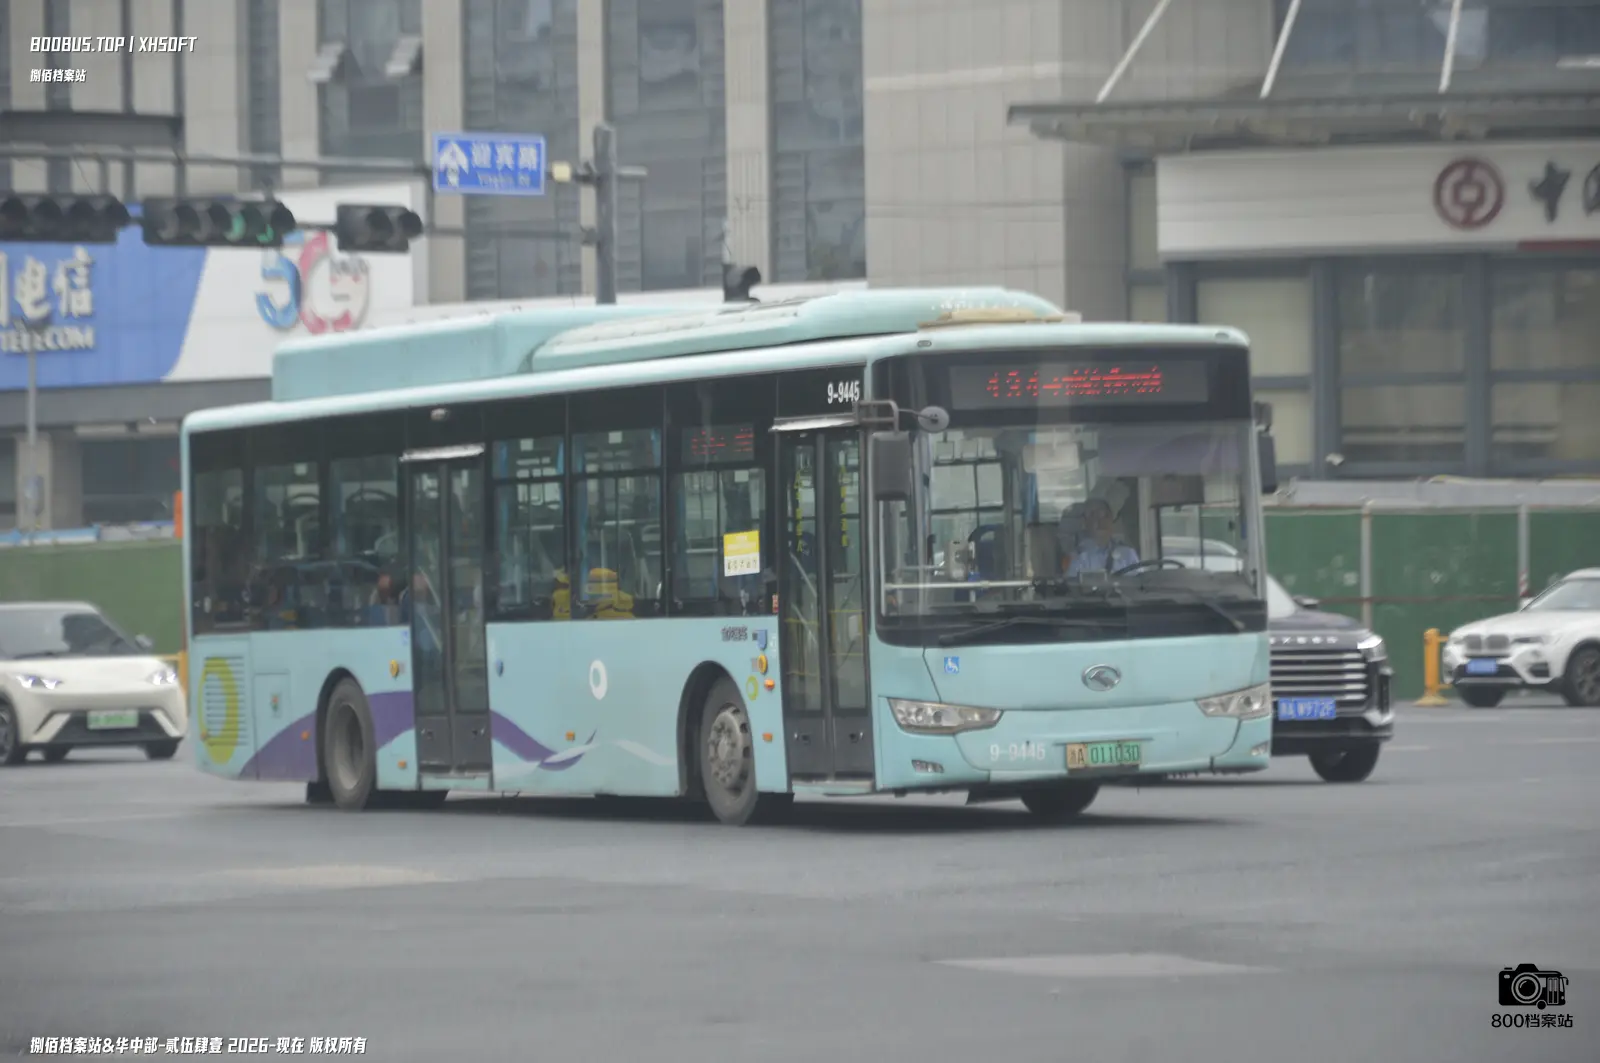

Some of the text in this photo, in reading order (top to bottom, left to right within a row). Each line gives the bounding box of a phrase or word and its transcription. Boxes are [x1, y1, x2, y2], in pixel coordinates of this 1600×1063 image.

[0, 245, 95, 326] 电信
[827, 380, 861, 405] 9-9445
[989, 743, 1047, 762] 9-9445
